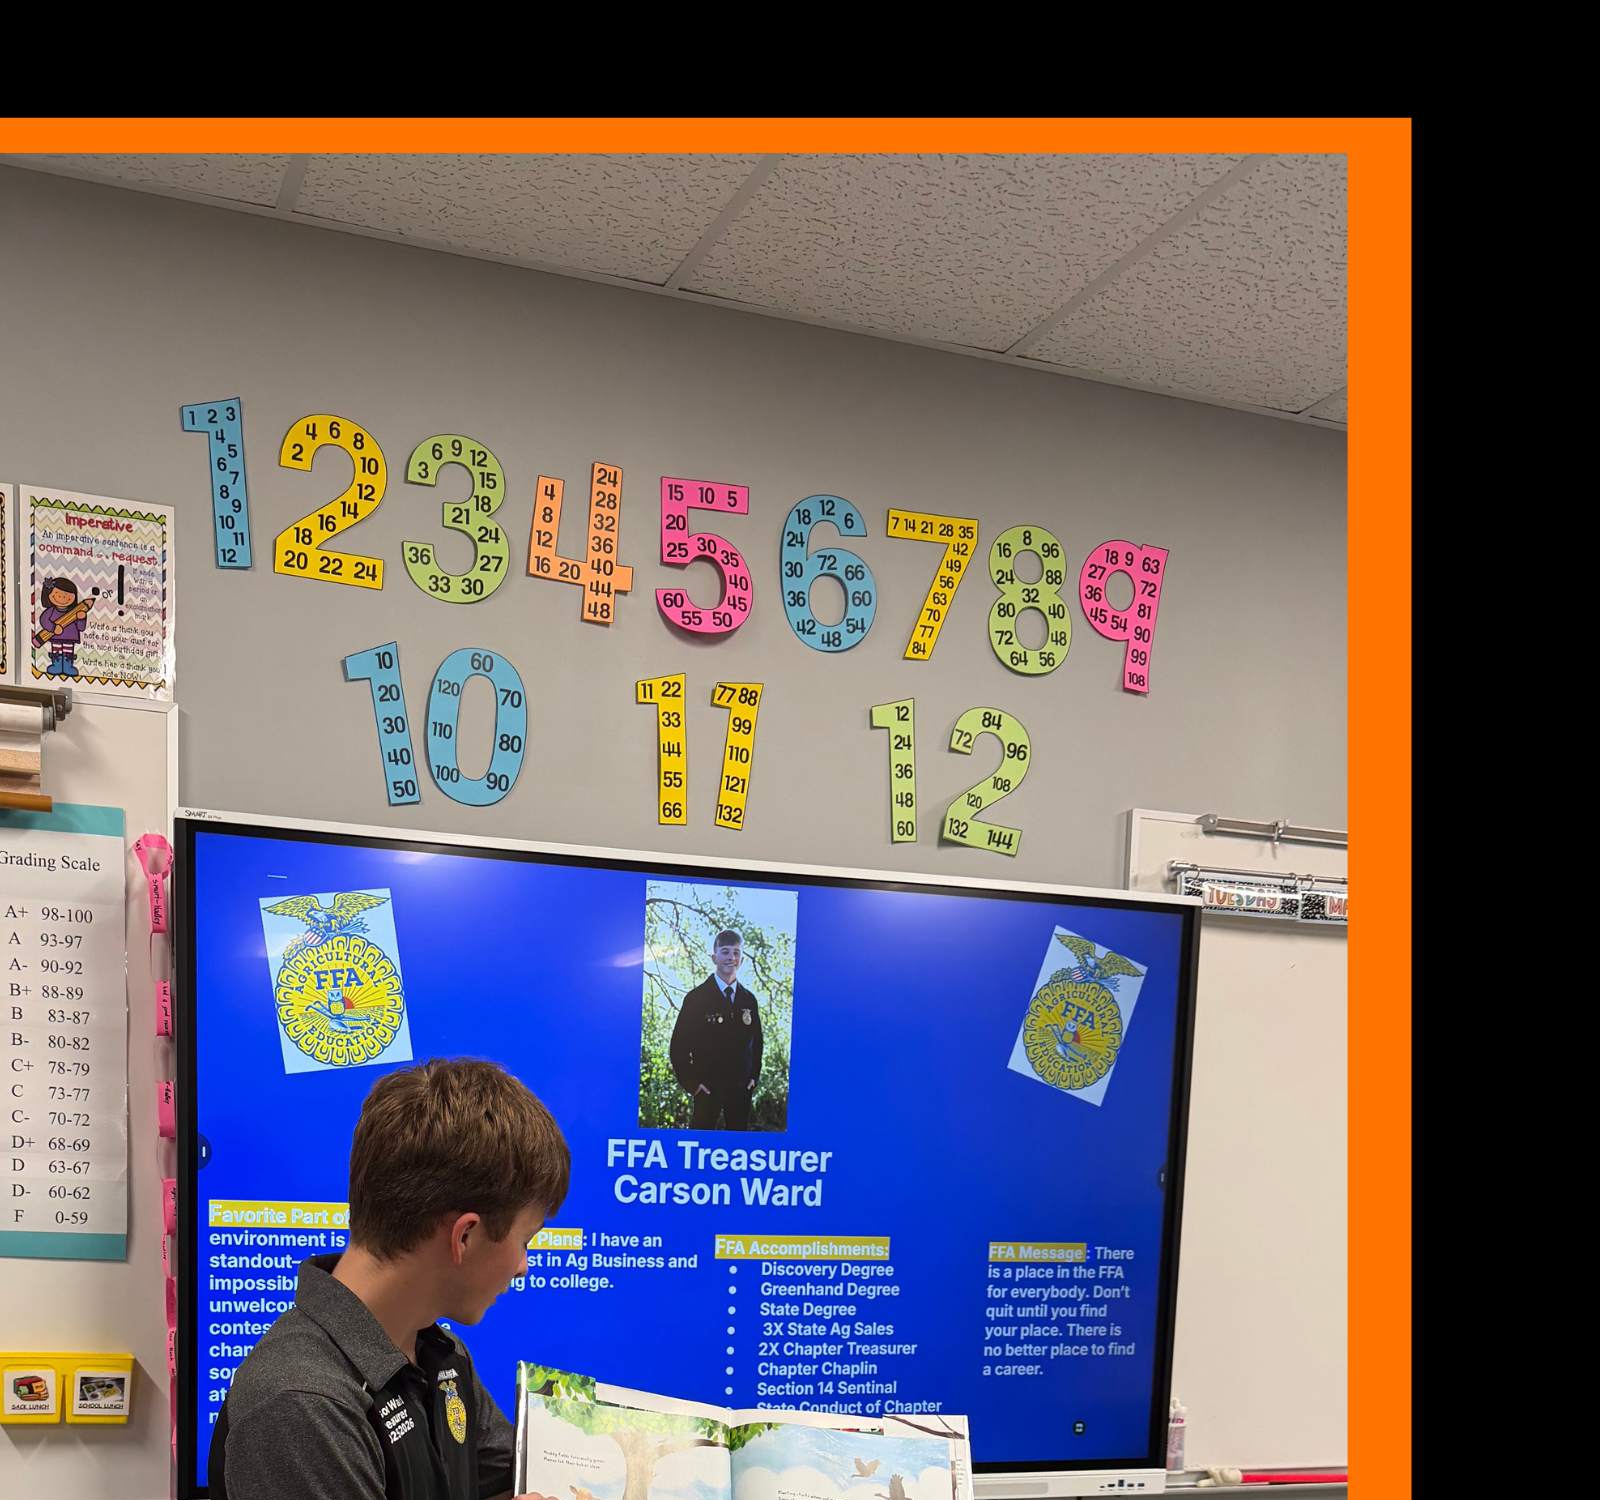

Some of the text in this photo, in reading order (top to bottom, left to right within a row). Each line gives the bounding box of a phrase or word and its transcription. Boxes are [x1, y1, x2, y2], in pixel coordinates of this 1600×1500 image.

[65, 512, 134, 534] Imperative
[480, 555, 503, 572] 27
[591, 558, 613, 576] 40
[499, 734, 521, 753] 80
[393, 780, 415, 797] 50
[725, 775, 745, 793] 121
[62, 856, 100, 871] Scale
[1207, 886, 1278, 913] TUESDAY
[5, 905, 92, 924] A+ 98-100
[12, 1007, 89, 1024] B 83-87
[608, 1139, 832, 1172] FFA Treasurer
[615, 1175, 822, 1206] Carson Ward
[715, 1239, 889, 1259] FFA Accomplishments:
[762, 1262, 894, 1279] Discovery Degree
[761, 1282, 843, 1295] Greenhand
[987, 1285, 1008, 1298] for
[1011, 1285, 1089, 1301] everybody.
[763, 1322, 893, 1338] 3X State Ag Sales
[995, 1365, 1043, 1375] career.
[757, 1380, 896, 1395] Section 14 Sentinal
